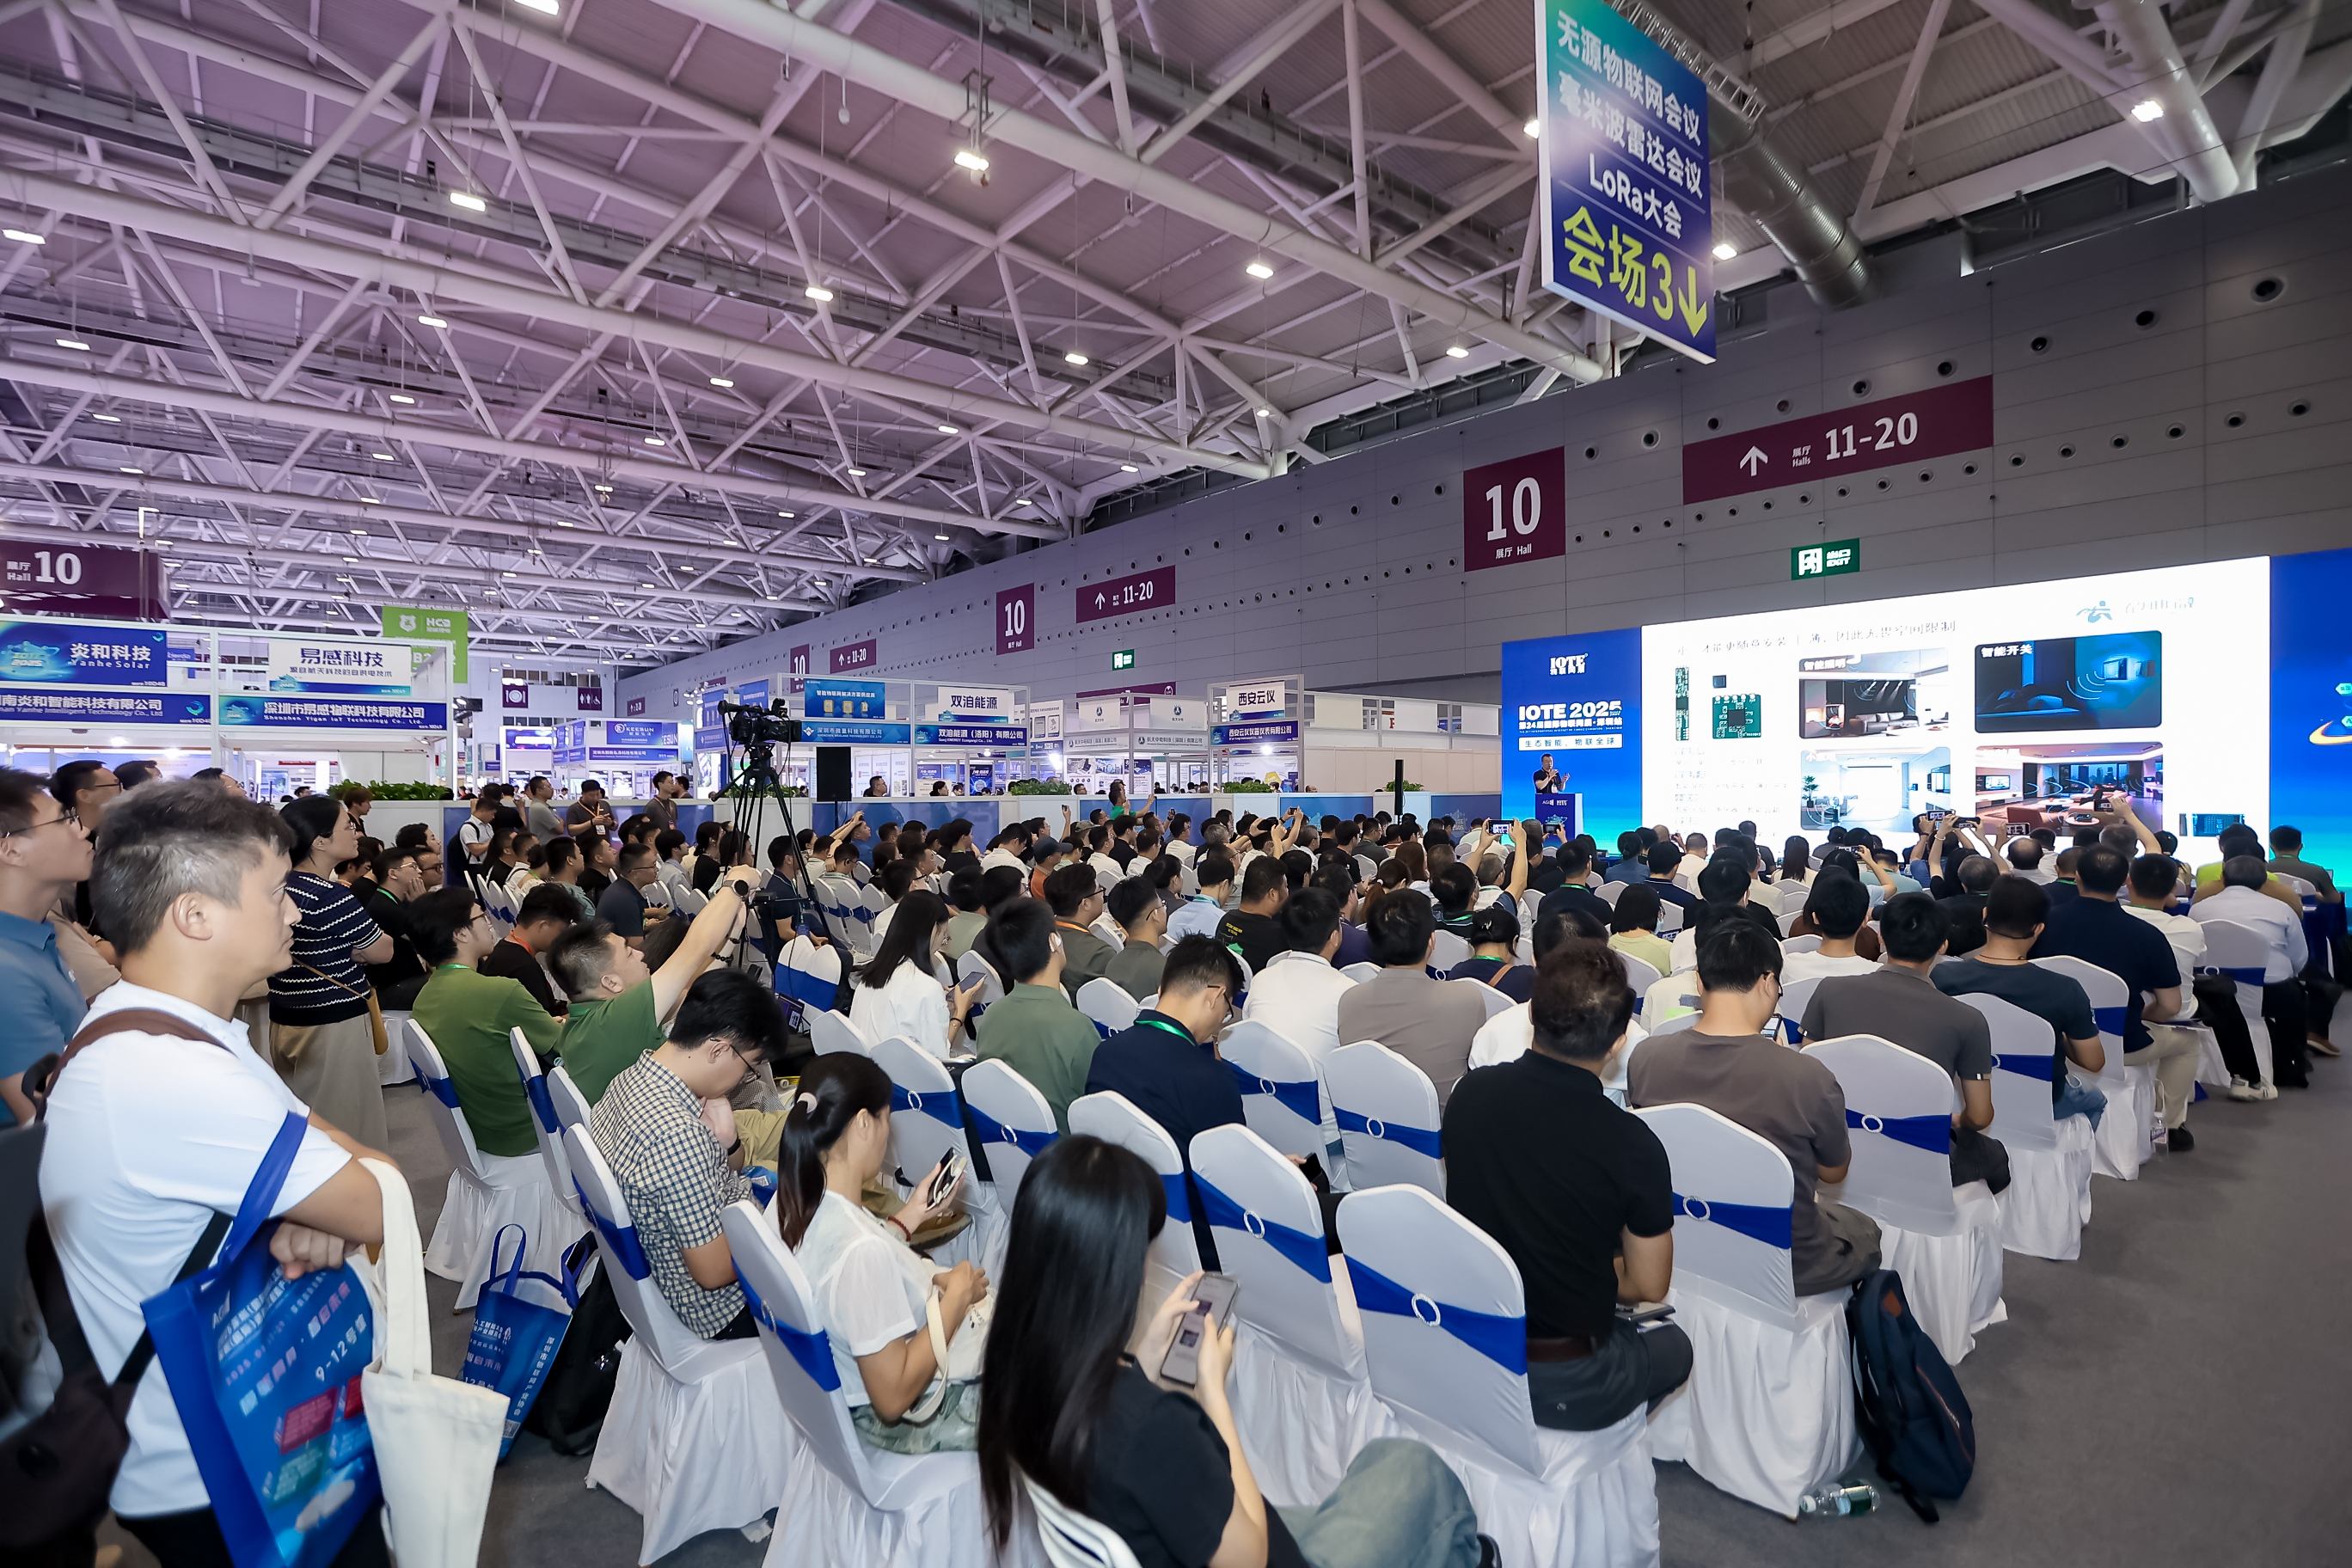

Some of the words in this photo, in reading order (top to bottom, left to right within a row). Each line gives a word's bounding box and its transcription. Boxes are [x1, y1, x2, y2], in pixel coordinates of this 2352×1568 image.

[1557, 9, 1701, 146] 无源物联网会议
[1559, 70, 1704, 199] 毫米波雷达会议
[1589, 153, 1682, 240] LoRa大会
[1563, 206, 1675, 321] 会场3
[1825, 413, 1918, 461] 11-20
[1792, 445, 1811, 457] 展厅
[1792, 456, 1811, 467] Halls
[1485, 477, 1541, 541] 10
[1496, 547, 1513, 560] 展厅
[1516, 543, 1532, 555] Hall
[7, 561, 31, 571] 展厅
[34, 551, 82, 585] 10
[7, 572, 31, 581] Hall
[1123, 580, 1154, 604] 11-20
[1004, 599, 1026, 637] 10
[70, 643, 151, 661] 炎和科技
[300, 647, 383, 668] 易感科技
[852, 647, 867, 663] 11-20
[1981, 644, 2033, 658] 智能开关
[70, 659, 113, 668] Yanhe
[793, 654, 805, 682] 10
[1238, 690, 1276, 707] 西安云仪
[264, 701, 425, 719] 深圳市易感物联科技有限公司
[1518, 703, 1566, 720] IOTE
[1569, 700, 1622, 719] 2025
